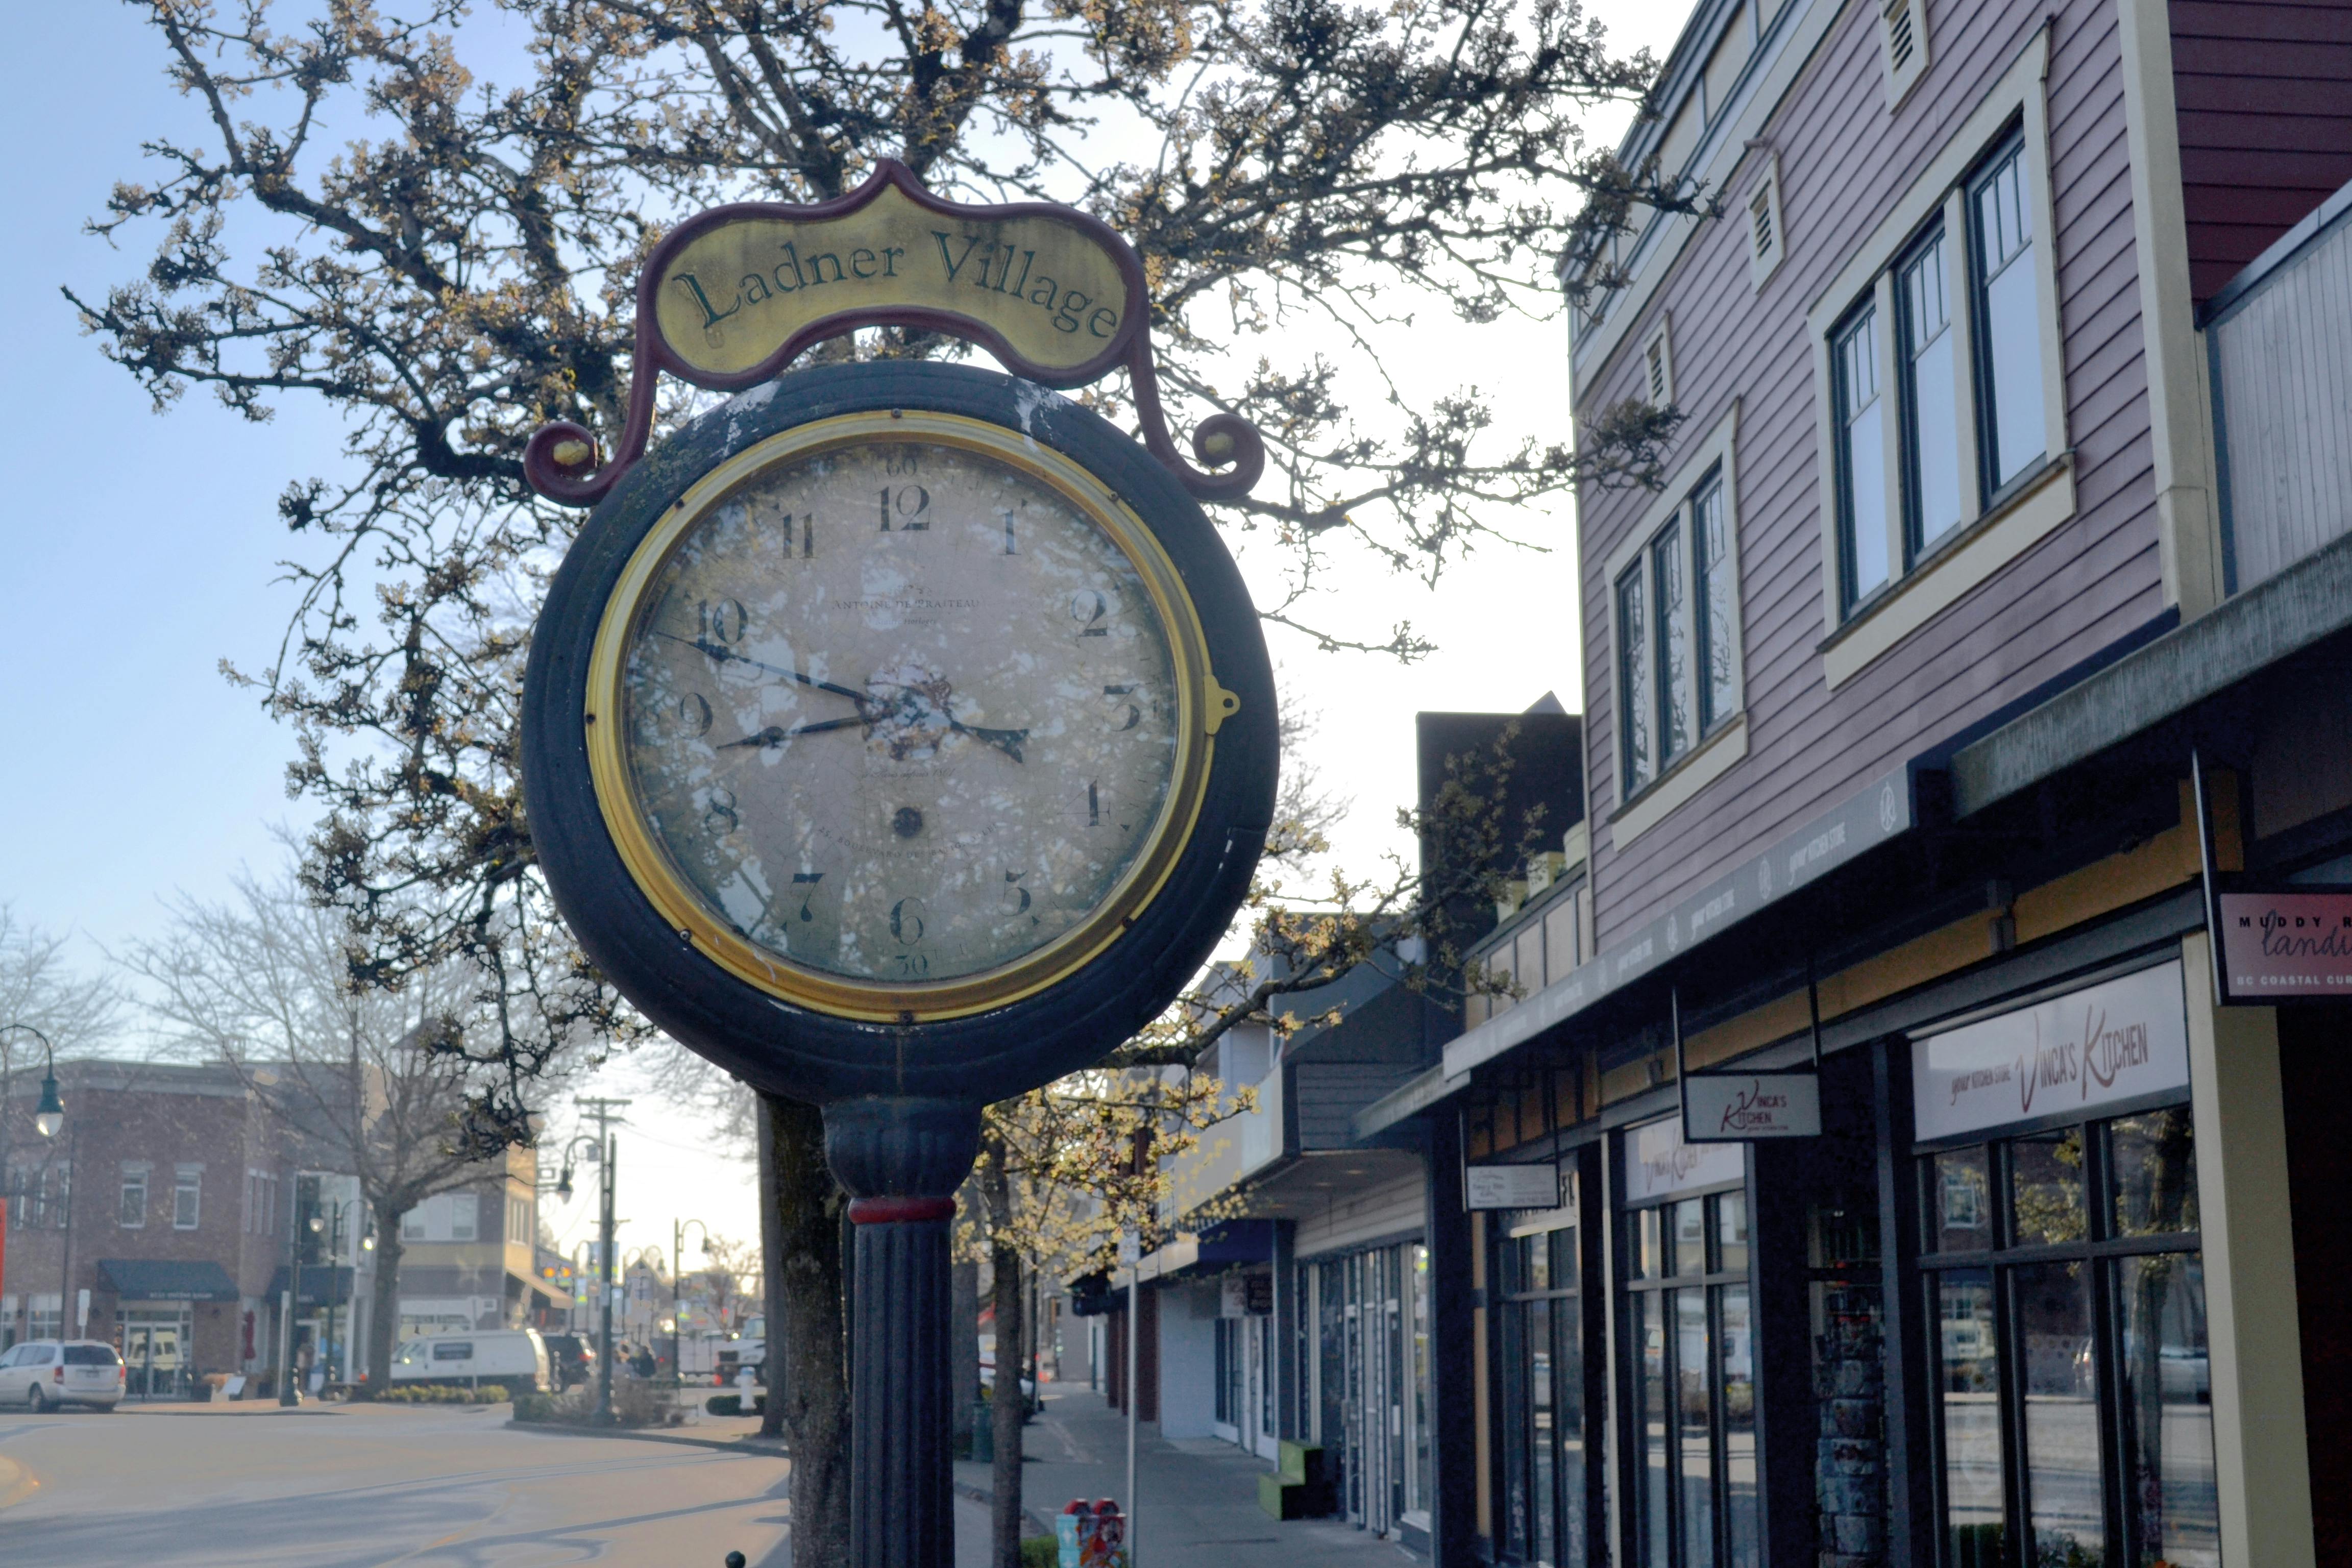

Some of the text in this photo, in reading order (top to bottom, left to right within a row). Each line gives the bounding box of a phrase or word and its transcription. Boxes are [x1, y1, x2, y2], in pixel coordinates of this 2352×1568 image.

[673, 230, 1117, 339] Ladner Village
[886, 458, 917, 478] 60
[874, 484, 932, 532] 12
[997, 508, 1021, 555] 1
[777, 511, 819, 559] 11
[695, 598, 748, 645] 10
[1071, 590, 1108, 637] 2
[676, 692, 713, 740] 9
[1096, 684, 1140, 732] 3
[704, 789, 739, 836] 8
[1058, 775, 1111, 828] 4
[791, 873, 826, 922] 7
[995, 867, 1032, 916] 5
[890, 897, 925, 946] 6
[2239, 917, 2321, 928] MUDDY
[895, 954, 928, 974] 30
[2237, 976, 2254, 986] BC
[2260, 975, 2321, 986] COASTAL
[2016, 1003, 2148, 1114] VINCA'S KITCHEN
[1951, 1075, 1970, 1106] your
[1971, 1069, 1994, 1089] KITCHEN
